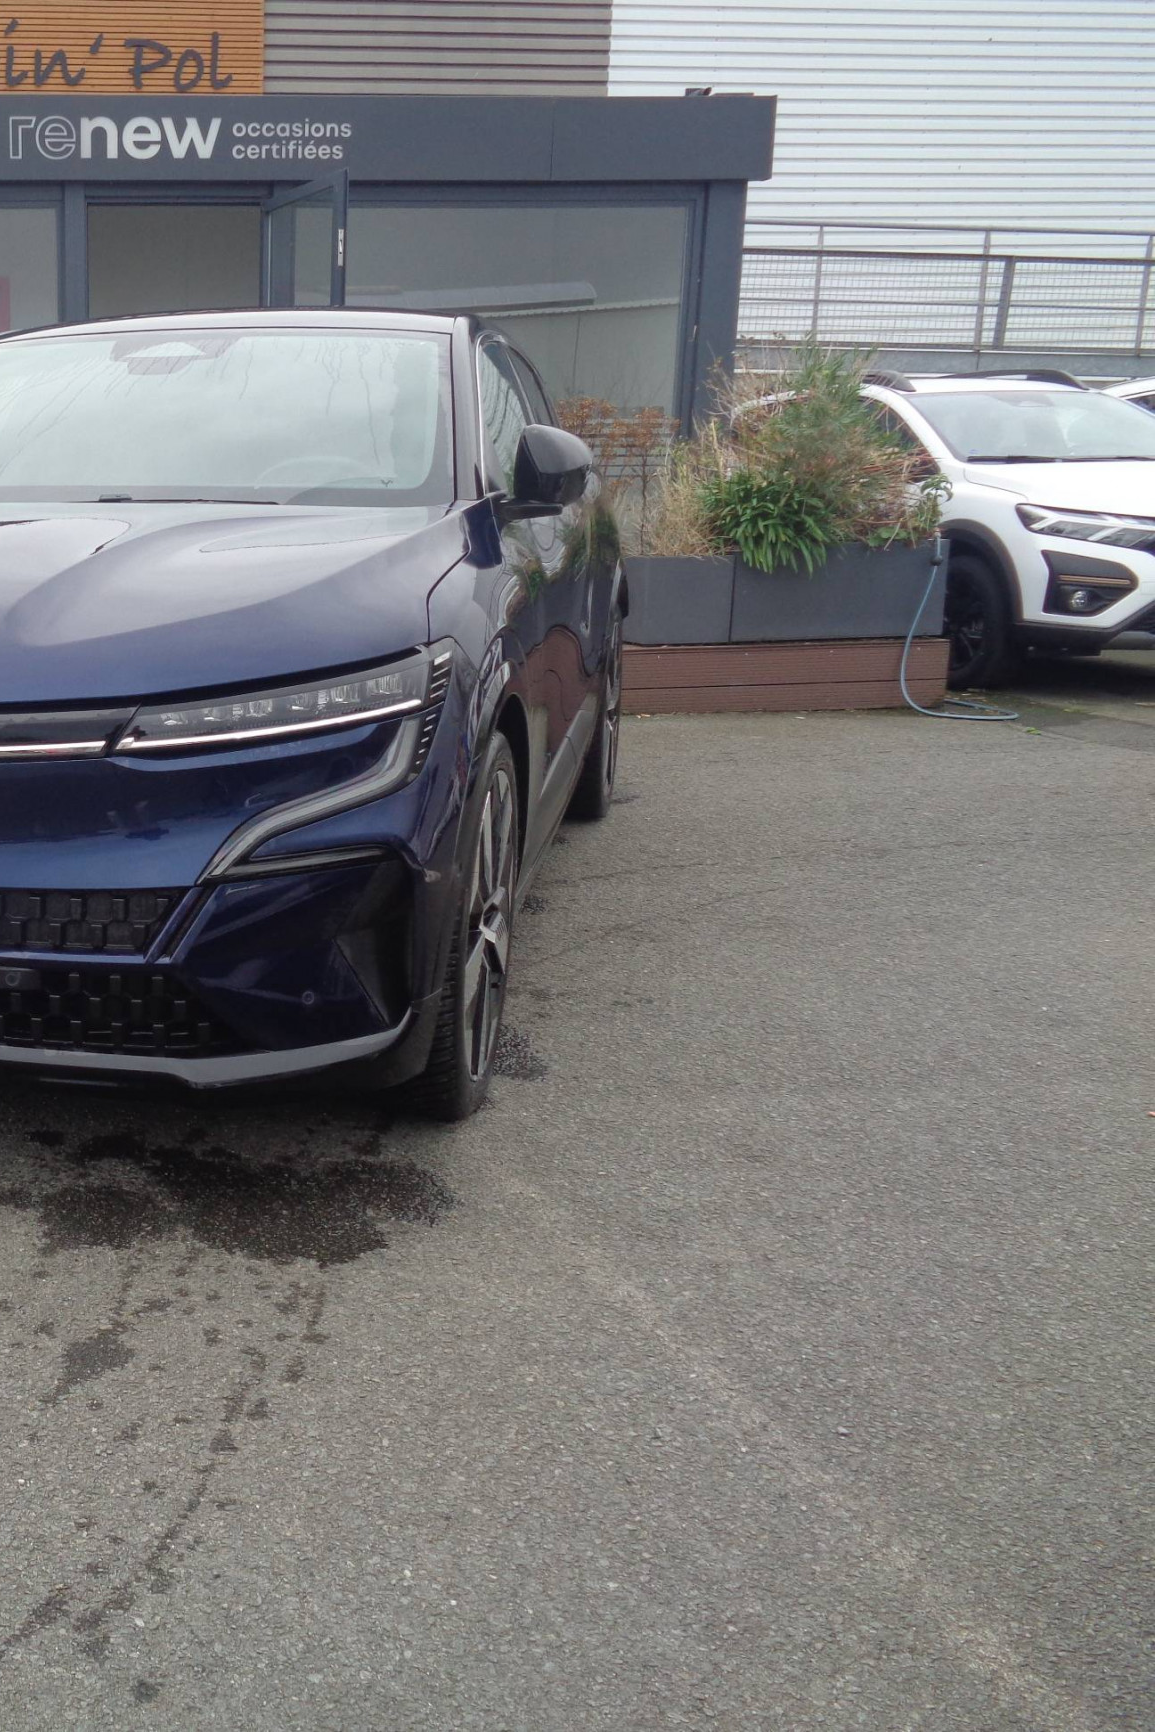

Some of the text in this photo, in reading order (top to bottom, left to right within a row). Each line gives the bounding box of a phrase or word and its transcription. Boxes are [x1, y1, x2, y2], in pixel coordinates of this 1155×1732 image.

[124, 31, 233, 92] Pol
[9, 115, 222, 160] renew
[232, 118, 352, 138] occasions
[232, 140, 344, 160] certifiées
